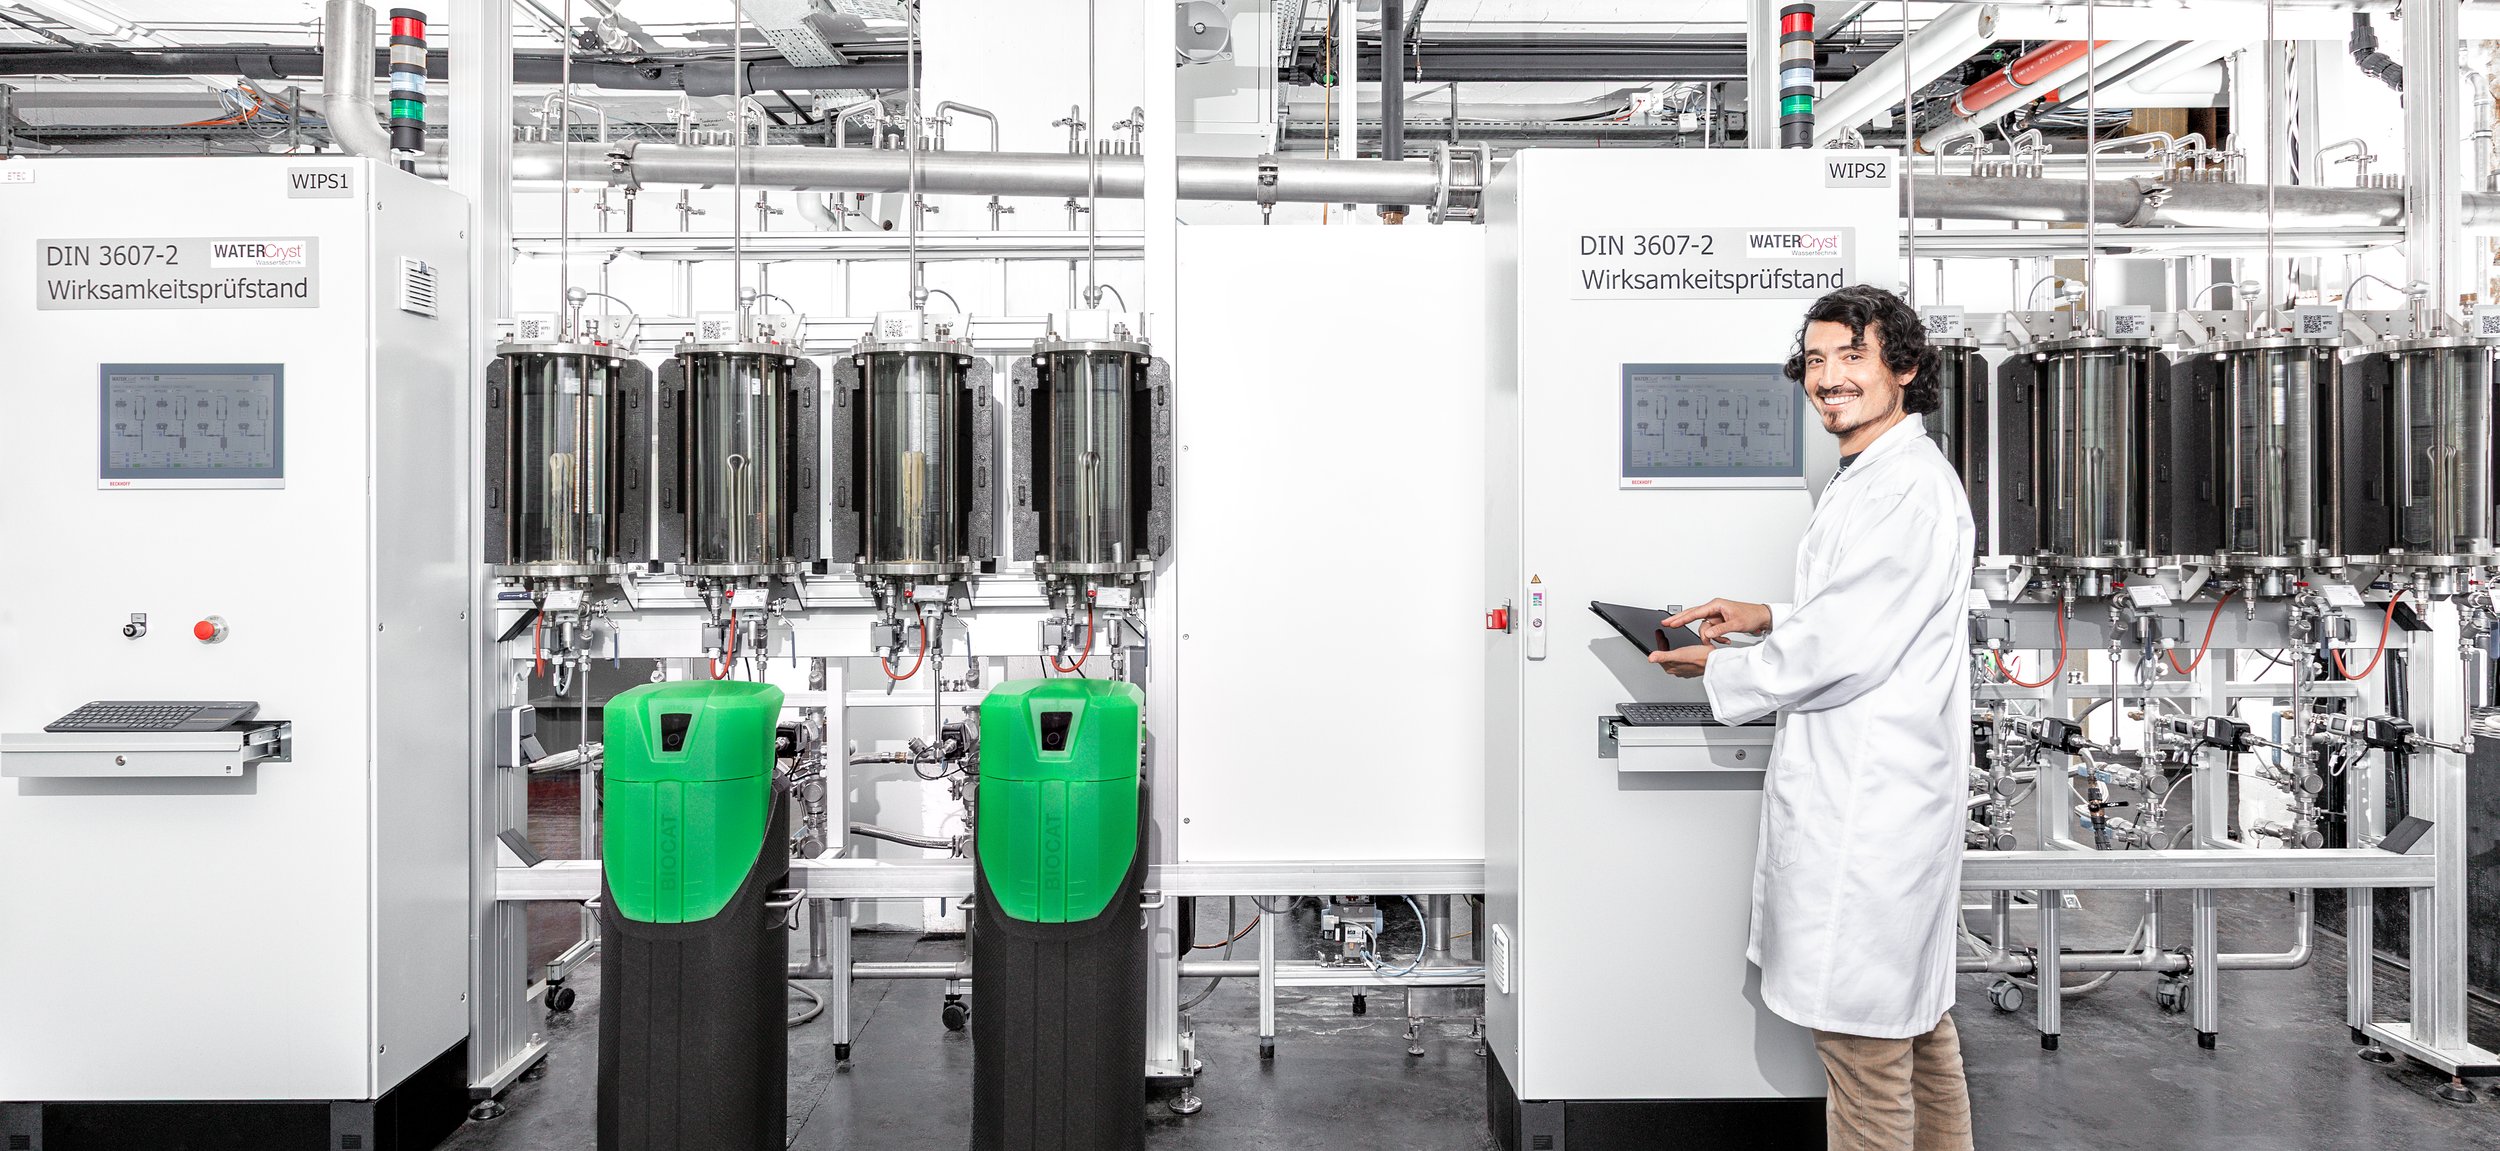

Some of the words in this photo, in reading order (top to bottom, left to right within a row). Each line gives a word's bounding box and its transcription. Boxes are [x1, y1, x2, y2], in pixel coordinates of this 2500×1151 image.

[291, 173, 349, 189] WIPS1
[1829, 162, 1887, 179] WIPS2
[47, 245, 90, 266] DIN
[99, 244, 179, 266] 3607-2
[1580, 235, 1624, 256] DIN
[1633, 234, 1714, 256] 3607-2
[48, 277, 308, 304] Wirksamkeitsprüfstand
[1581, 268, 1844, 294] Wirksamkeitsprüfstand
[660, 814, 677, 891] BIOCAT
[1045, 813, 1061, 890] BIOCAT
